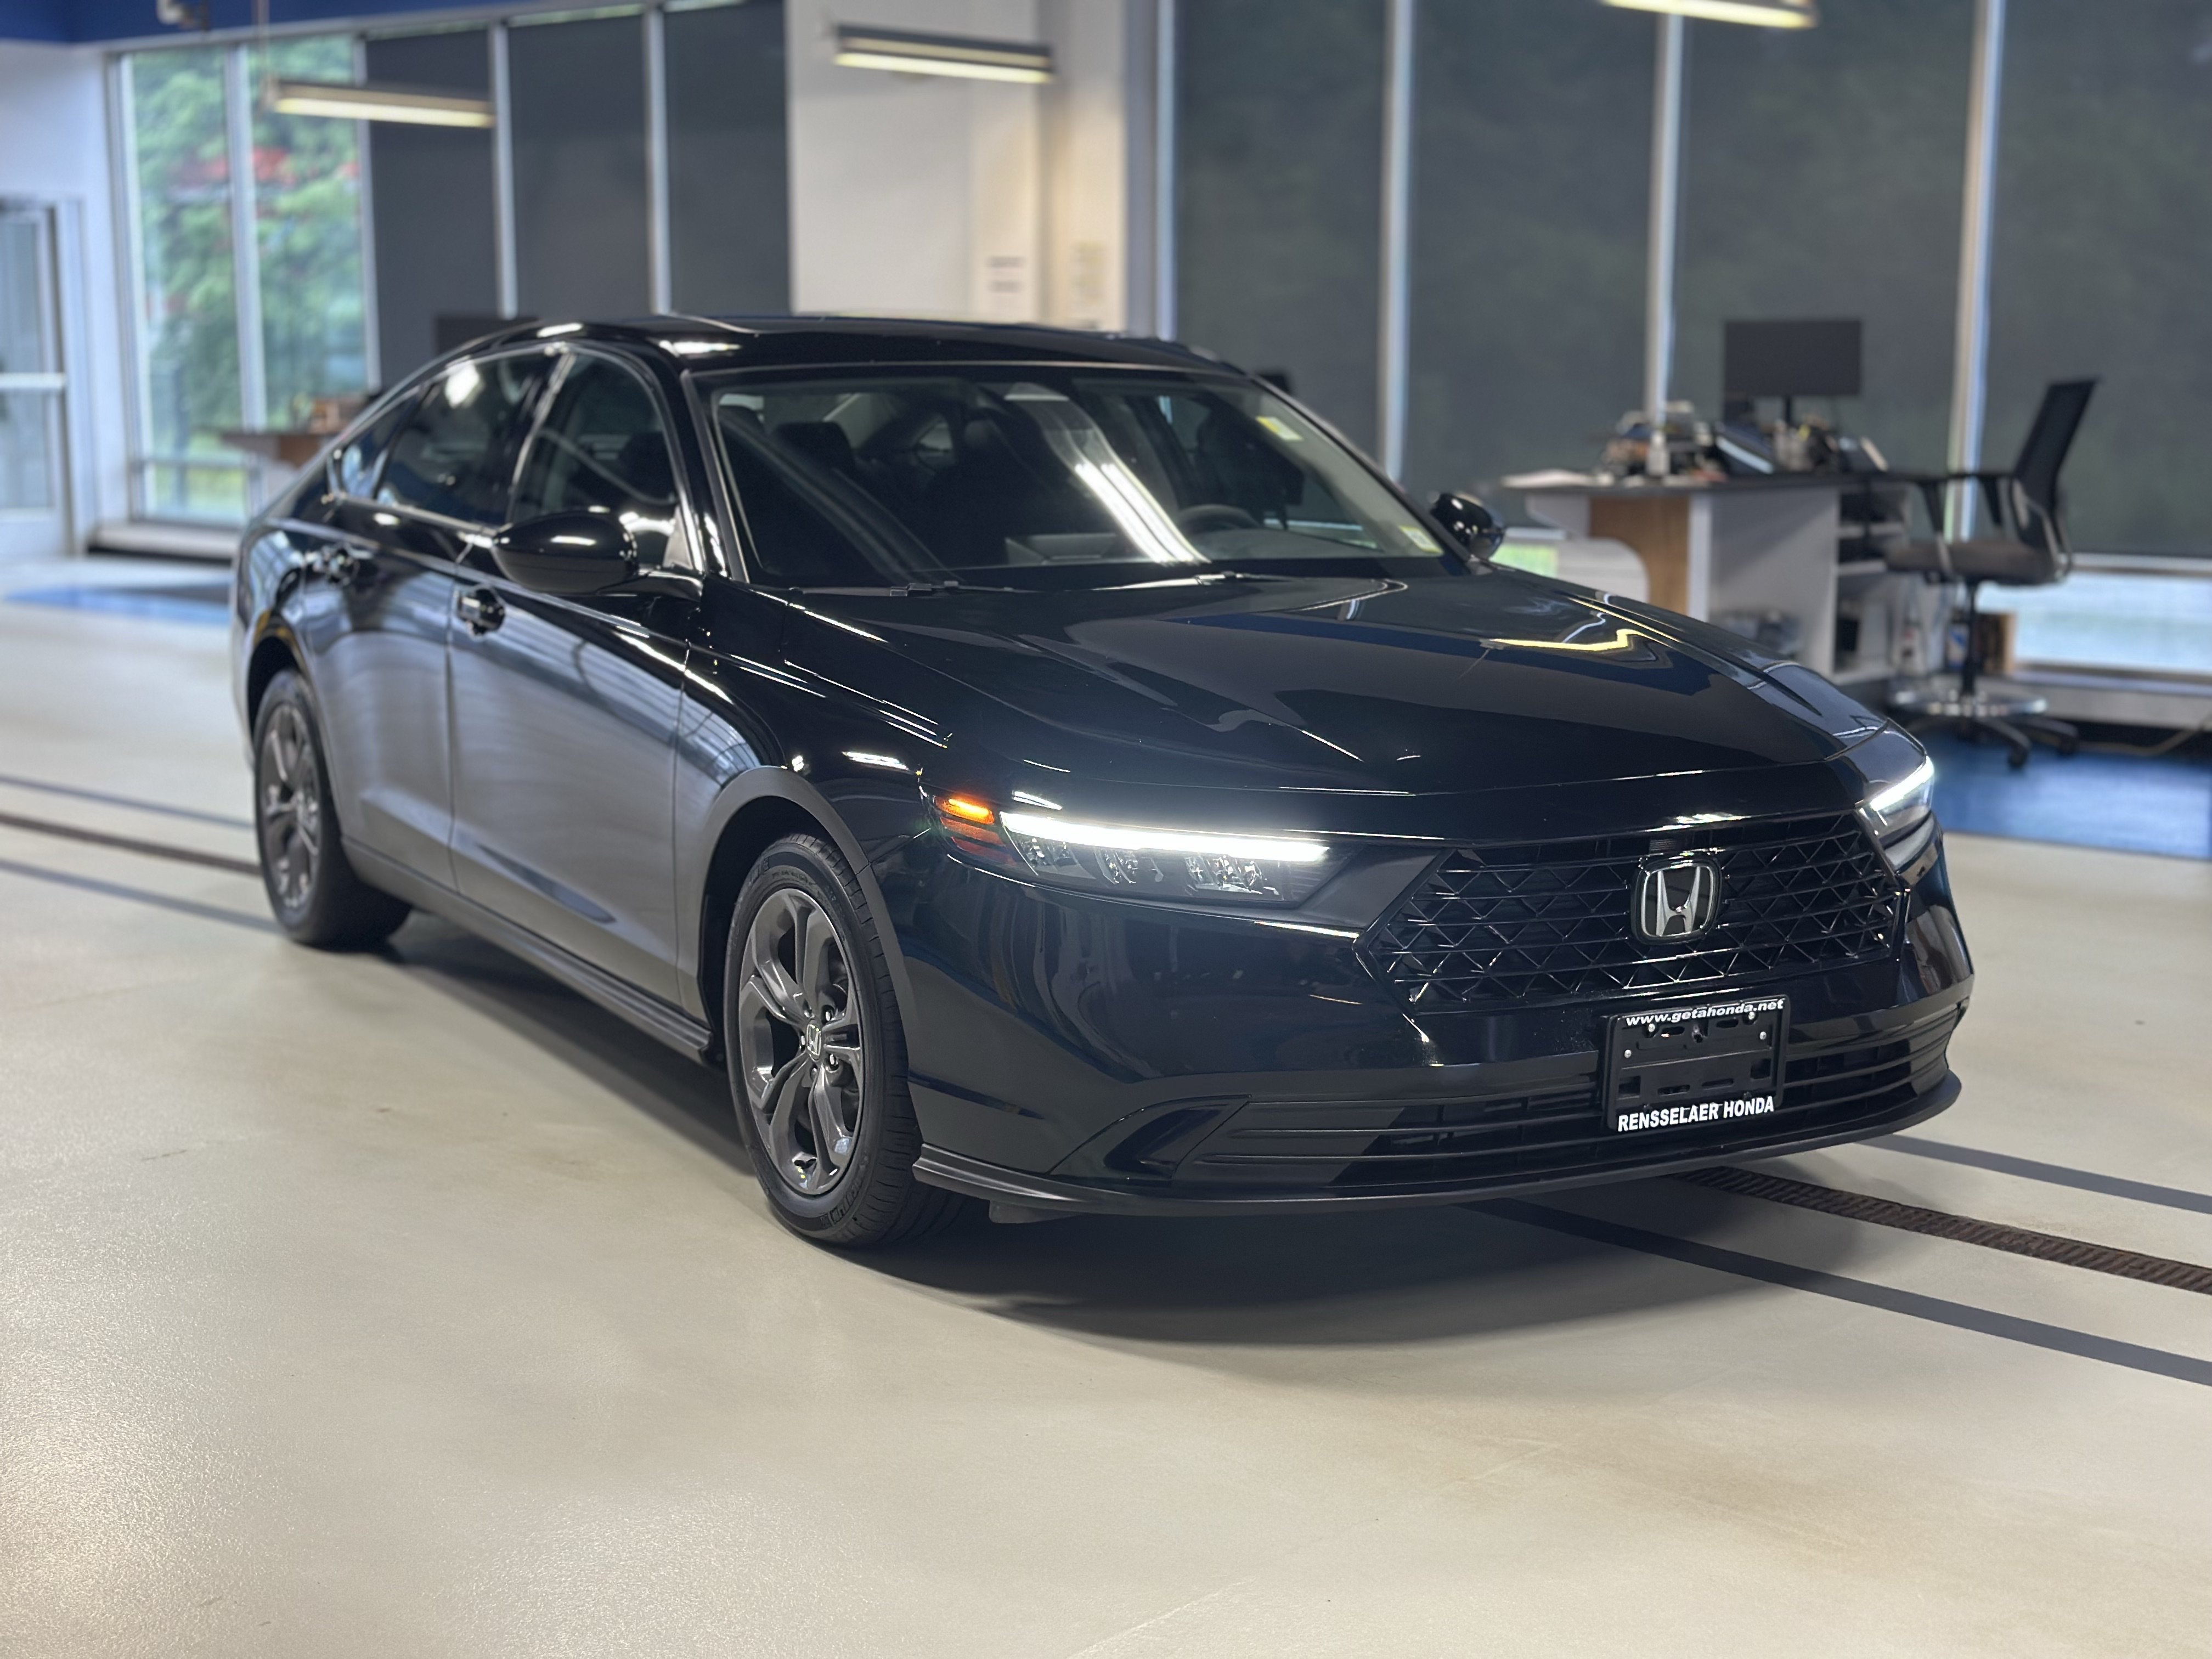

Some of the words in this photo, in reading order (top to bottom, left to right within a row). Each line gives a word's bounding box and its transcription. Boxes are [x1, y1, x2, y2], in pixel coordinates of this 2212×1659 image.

[1626, 998, 1784, 1026] www.getahonda.net
[1618, 1103, 1718, 1132] RENSSELAER
[1723, 1096, 1774, 1118] HONDA
